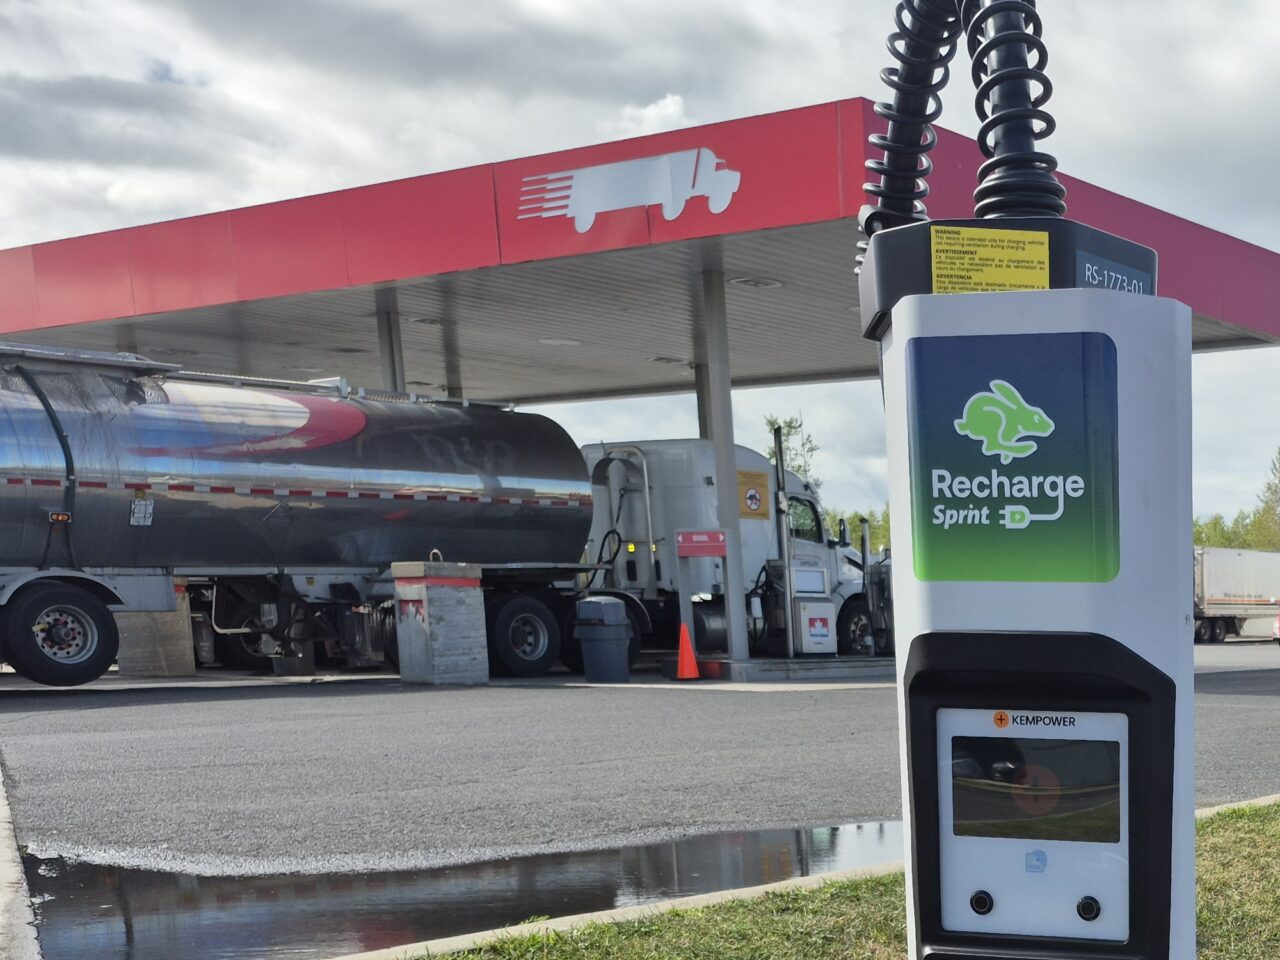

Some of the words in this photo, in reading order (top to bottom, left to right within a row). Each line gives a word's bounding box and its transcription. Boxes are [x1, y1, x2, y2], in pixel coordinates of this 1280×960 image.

[1085, 263, 1143, 295] RS-1773-01
[931, 468, 1085, 499] Recharge
[932, 503, 990, 530] Sprint
[1012, 714, 1076, 727] KEMPOWER
